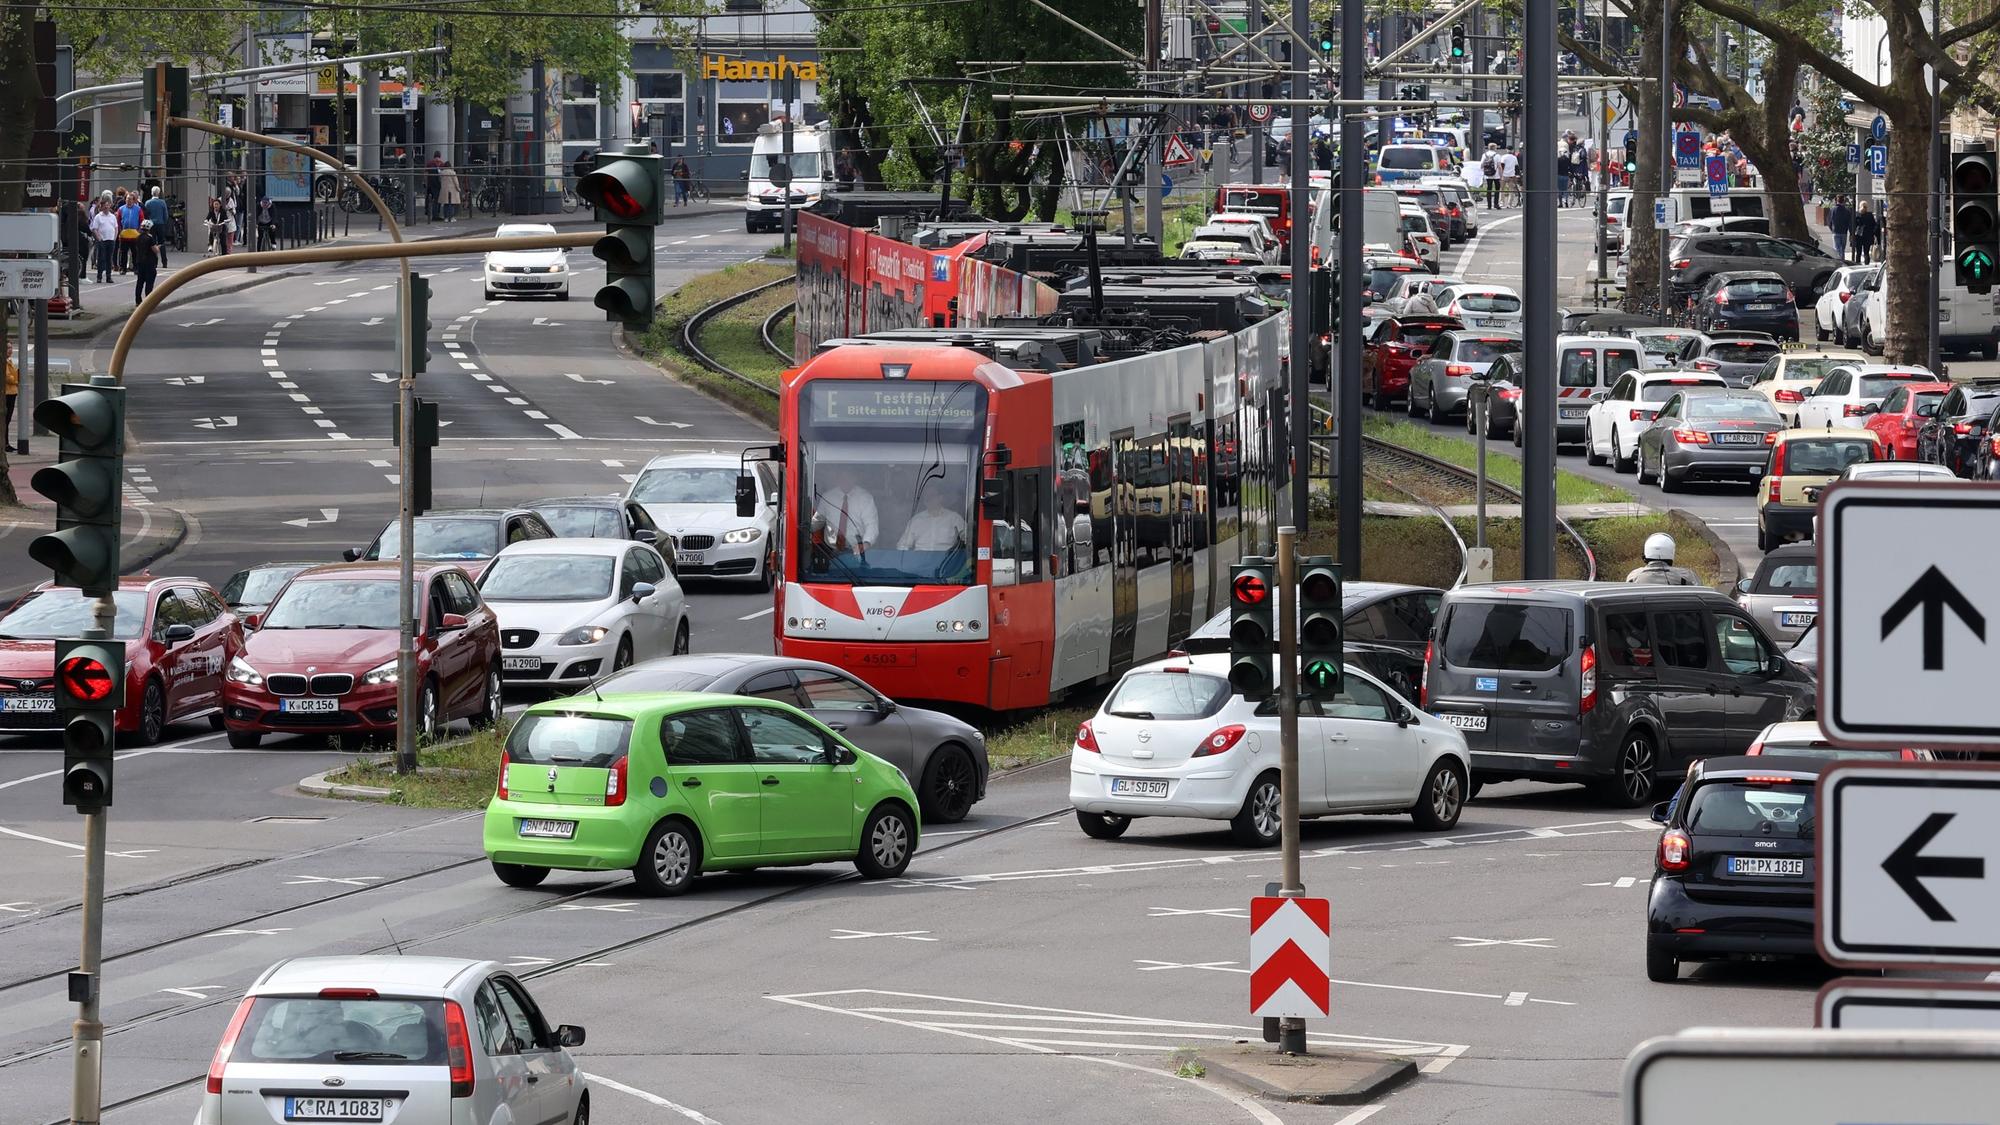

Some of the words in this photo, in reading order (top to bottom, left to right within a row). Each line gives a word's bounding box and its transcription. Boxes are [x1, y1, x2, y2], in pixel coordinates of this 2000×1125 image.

[1253, 106, 1266, 115] 30
[1678, 156, 1698, 165] TAXI
[1873, 150, 1882, 171] P
[1710, 183, 1727, 193] TAXI
[874, 391, 948, 405] Testfahrt
[827, 391, 838, 418] E
[847, 406, 877, 416] Bitte
[881, 406, 909, 416] nicht
[914, 407, 973, 418] einsteigen
[866, 607, 883, 616] KVB
[1787, 614, 1794, 624] K
[512, 658, 518, 668] A
[519, 658, 540, 669] 2900
[863, 653, 897, 664] 4503
[4, 699, 11, 709] K
[16, 699, 29, 709] ZE
[31, 699, 55, 709] 1972
[289, 700, 296, 711] K
[301, 700, 314, 711] CR
[316, 700, 334, 711] 156
[1463, 716, 1486, 728] 2146
[1118, 780, 1130, 791] GL
[1136, 781, 1148, 792] SD
[1149, 782, 1167, 793] 507
[526, 821, 537, 832] BN
[543, 822, 555, 833] AD
[556, 822, 572, 834] 700
[1735, 858, 1750, 872] BM
[1757, 859, 1772, 873] PX
[1774, 859, 1801, 873] 181E
[295, 1100, 305, 1115] K
[316, 1100, 336, 1116] RA
[339, 1100, 379, 1116] 1083
